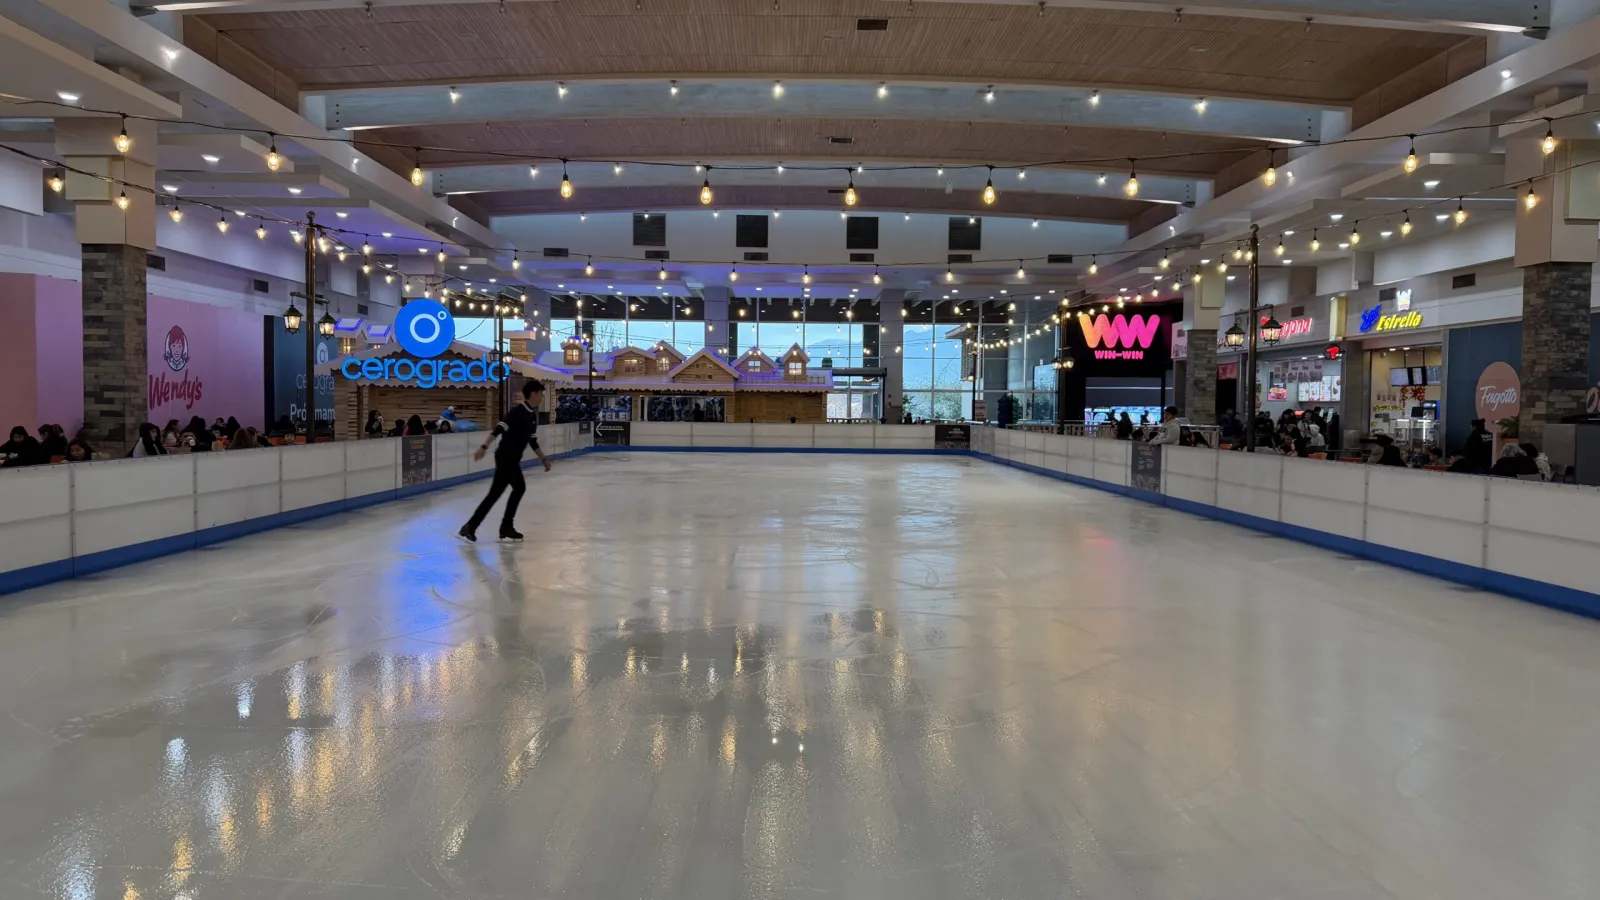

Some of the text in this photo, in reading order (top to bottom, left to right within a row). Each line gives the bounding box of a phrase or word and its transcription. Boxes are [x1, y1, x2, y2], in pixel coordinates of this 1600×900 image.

[1375, 311, 1422, 331] Estrella
[1094, 350, 1144, 360] WIN-WIN
[341, 354, 510, 388] cerogrado
[149, 369, 202, 410] Wendy's
[1480, 385, 1517, 412] Fagotto
